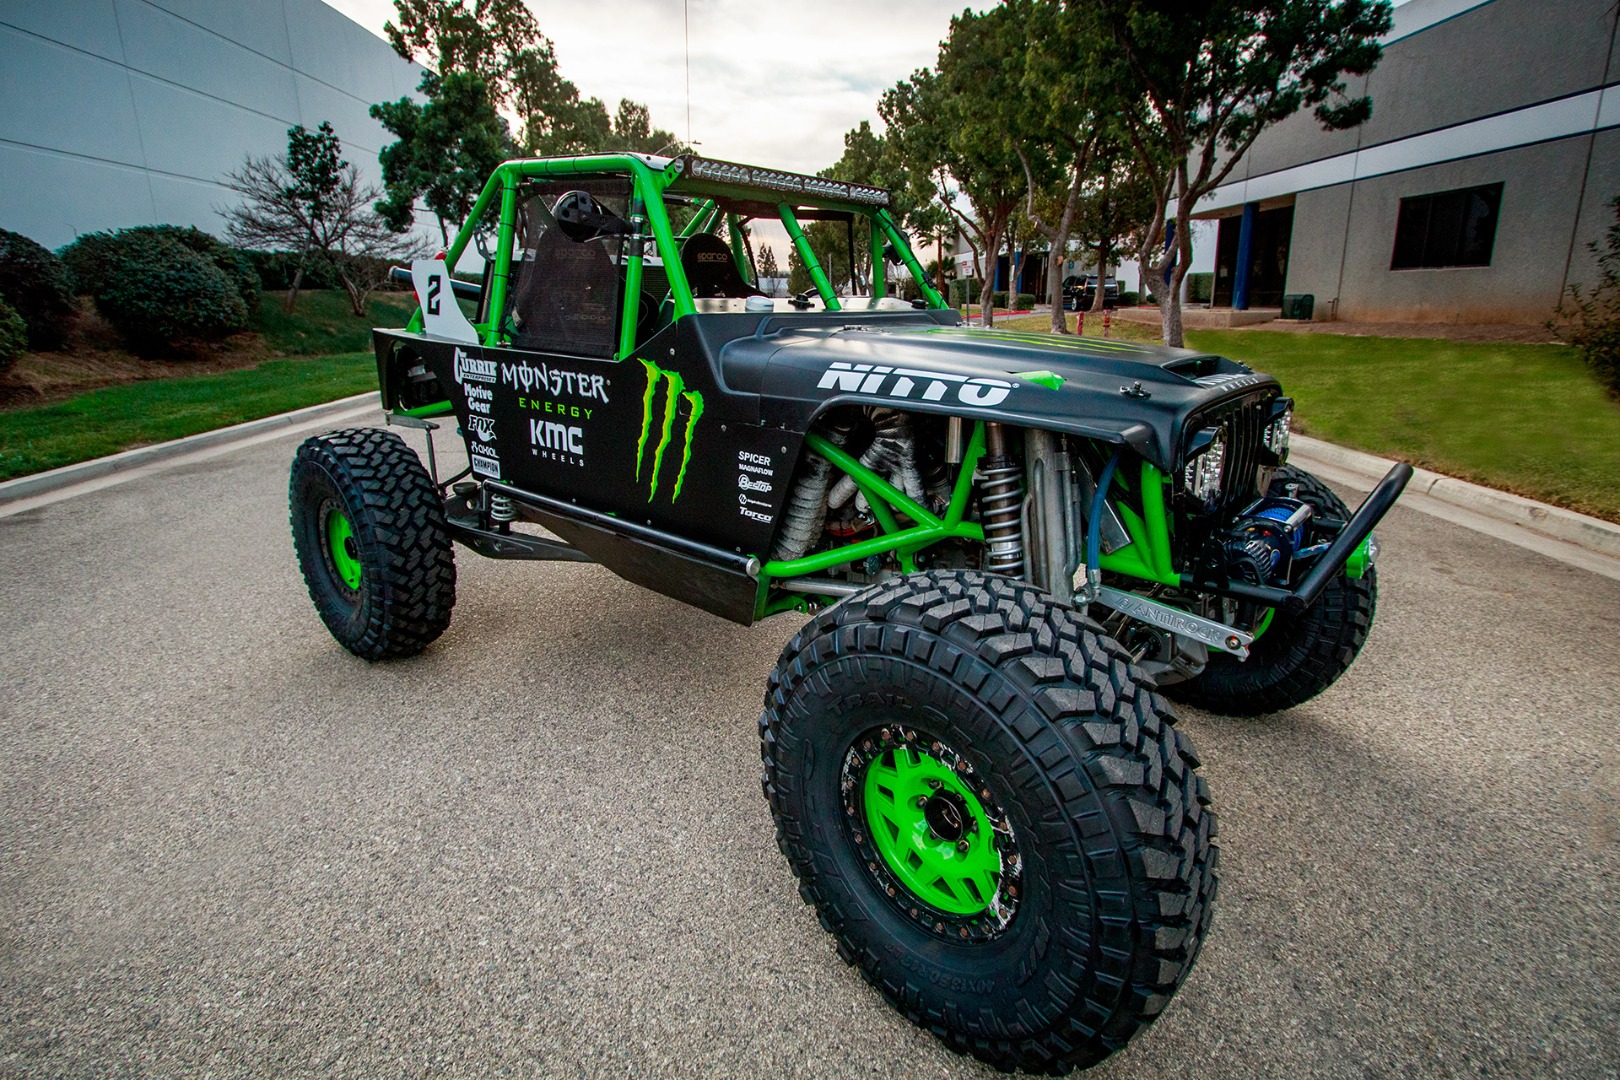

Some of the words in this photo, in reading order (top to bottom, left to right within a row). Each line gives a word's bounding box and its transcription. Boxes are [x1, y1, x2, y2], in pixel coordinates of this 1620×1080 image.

[697, 252, 728, 261] sparco
[428, 275, 441, 316] 2
[463, 383, 493, 400] Motive
[501, 360, 610, 404] MONSTER
[467, 397, 491, 414] Gear
[518, 397, 593, 420] ENERGY
[468, 414, 496, 438] FOX
[529, 418, 584, 456] KMC
[474, 457, 499, 473] CHAMPION
[531, 448, 584, 467] WHEELS
[738, 450, 771, 466] SPICER
[738, 463, 774, 477] MAGNAFLOW
[1132, 603, 1222, 645] ANTIROCK
